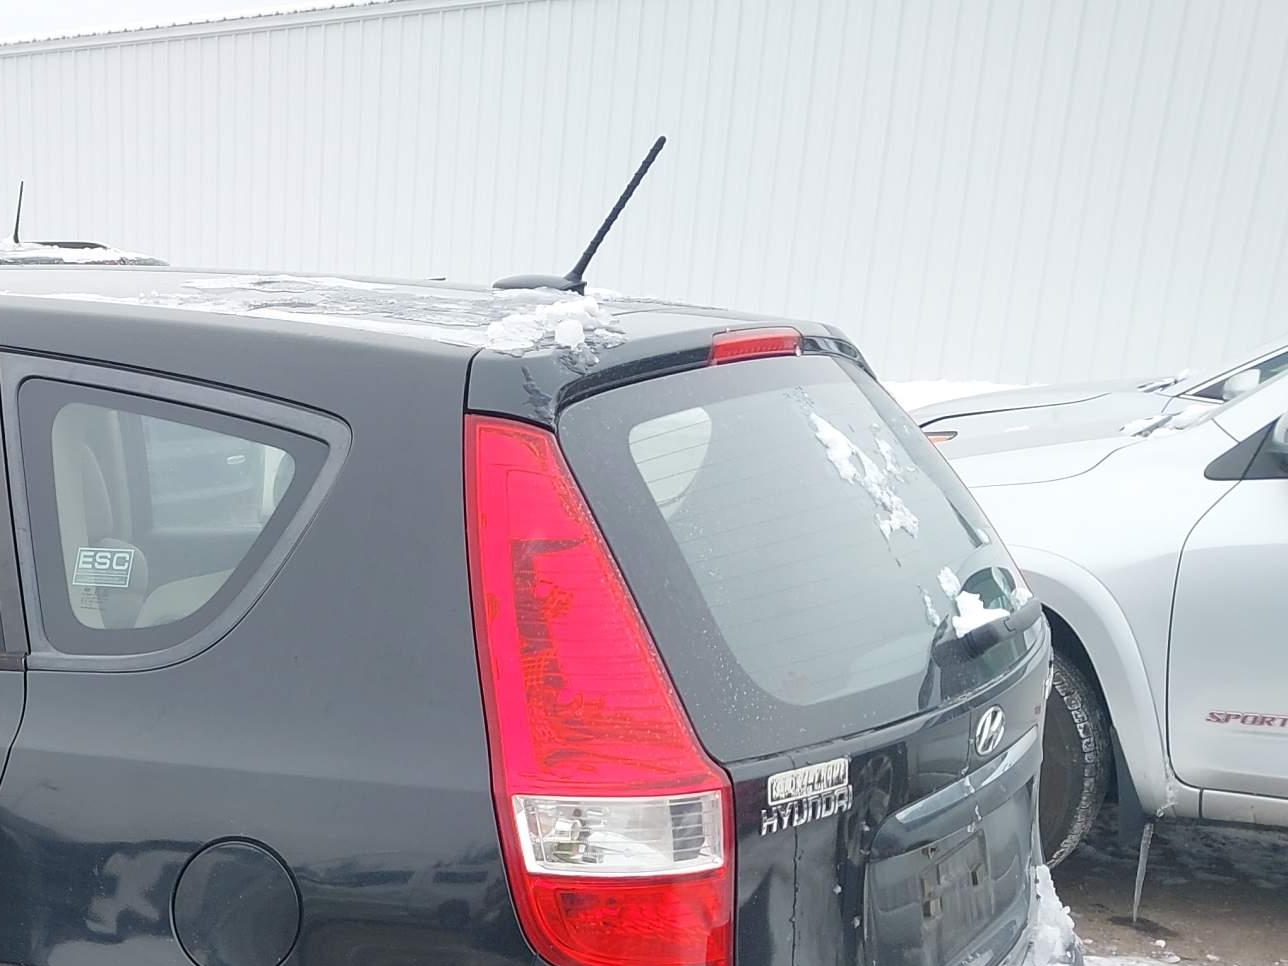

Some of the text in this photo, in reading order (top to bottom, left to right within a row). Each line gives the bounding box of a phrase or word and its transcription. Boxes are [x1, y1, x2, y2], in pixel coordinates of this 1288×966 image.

[78, 551, 130, 570] ESC
[1205, 711, 1288, 728] SPORT
[761, 784, 853, 836] HYUNDAI
